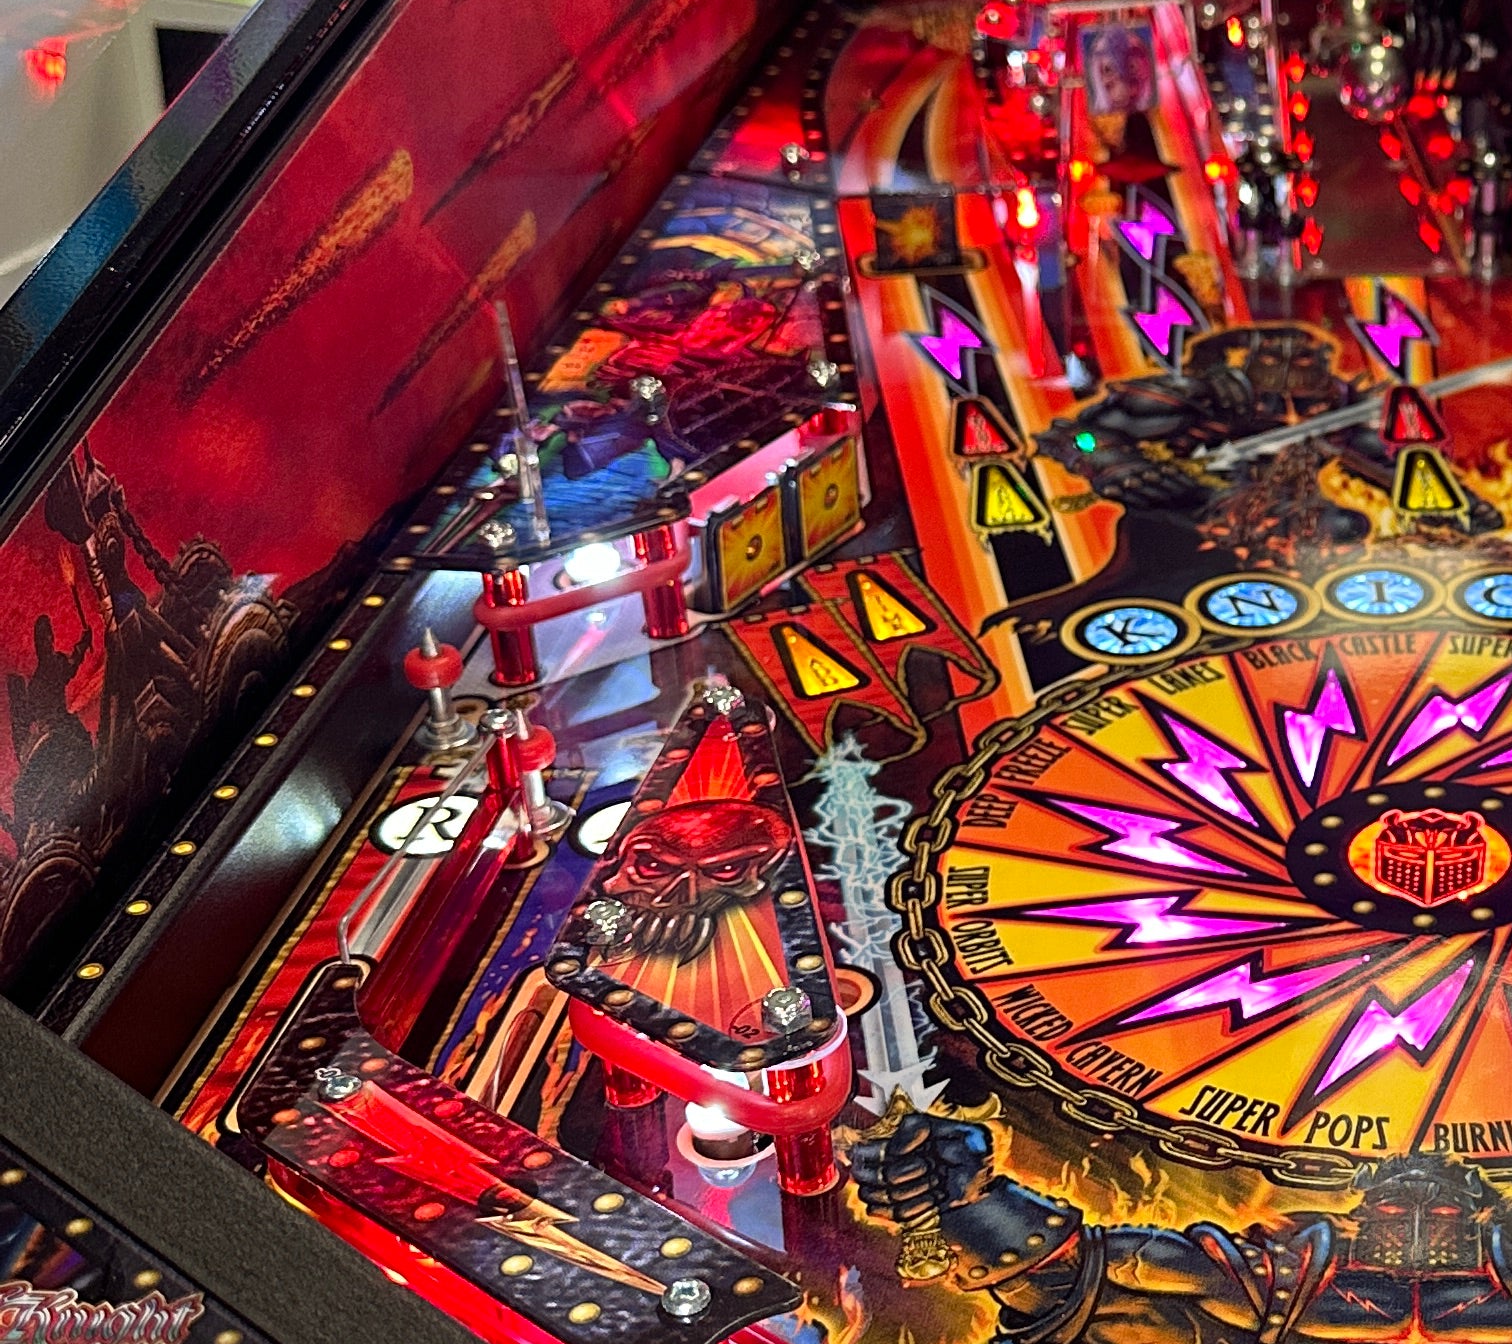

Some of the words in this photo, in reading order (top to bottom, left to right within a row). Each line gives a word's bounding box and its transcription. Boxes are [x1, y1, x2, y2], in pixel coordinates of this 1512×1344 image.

[1246, 638, 1318, 670] BLACK
[1339, 633, 1417, 657] CASTLE
[1061, 696, 1138, 736] SUPER
[1150, 660, 1226, 695] LANES
[961, 789, 1019, 829] DEEP
[1005, 736, 1072, 787] FREEZE
[945, 865, 990, 920] SUPER
[951, 919, 1015, 976] ORBITS
[992, 983, 1074, 1043] WICKED
[1069, 1040, 1163, 1100] CAVERN
[1179, 1084, 1282, 1138] SUPER
[1304, 1110, 1391, 1150] POPS
